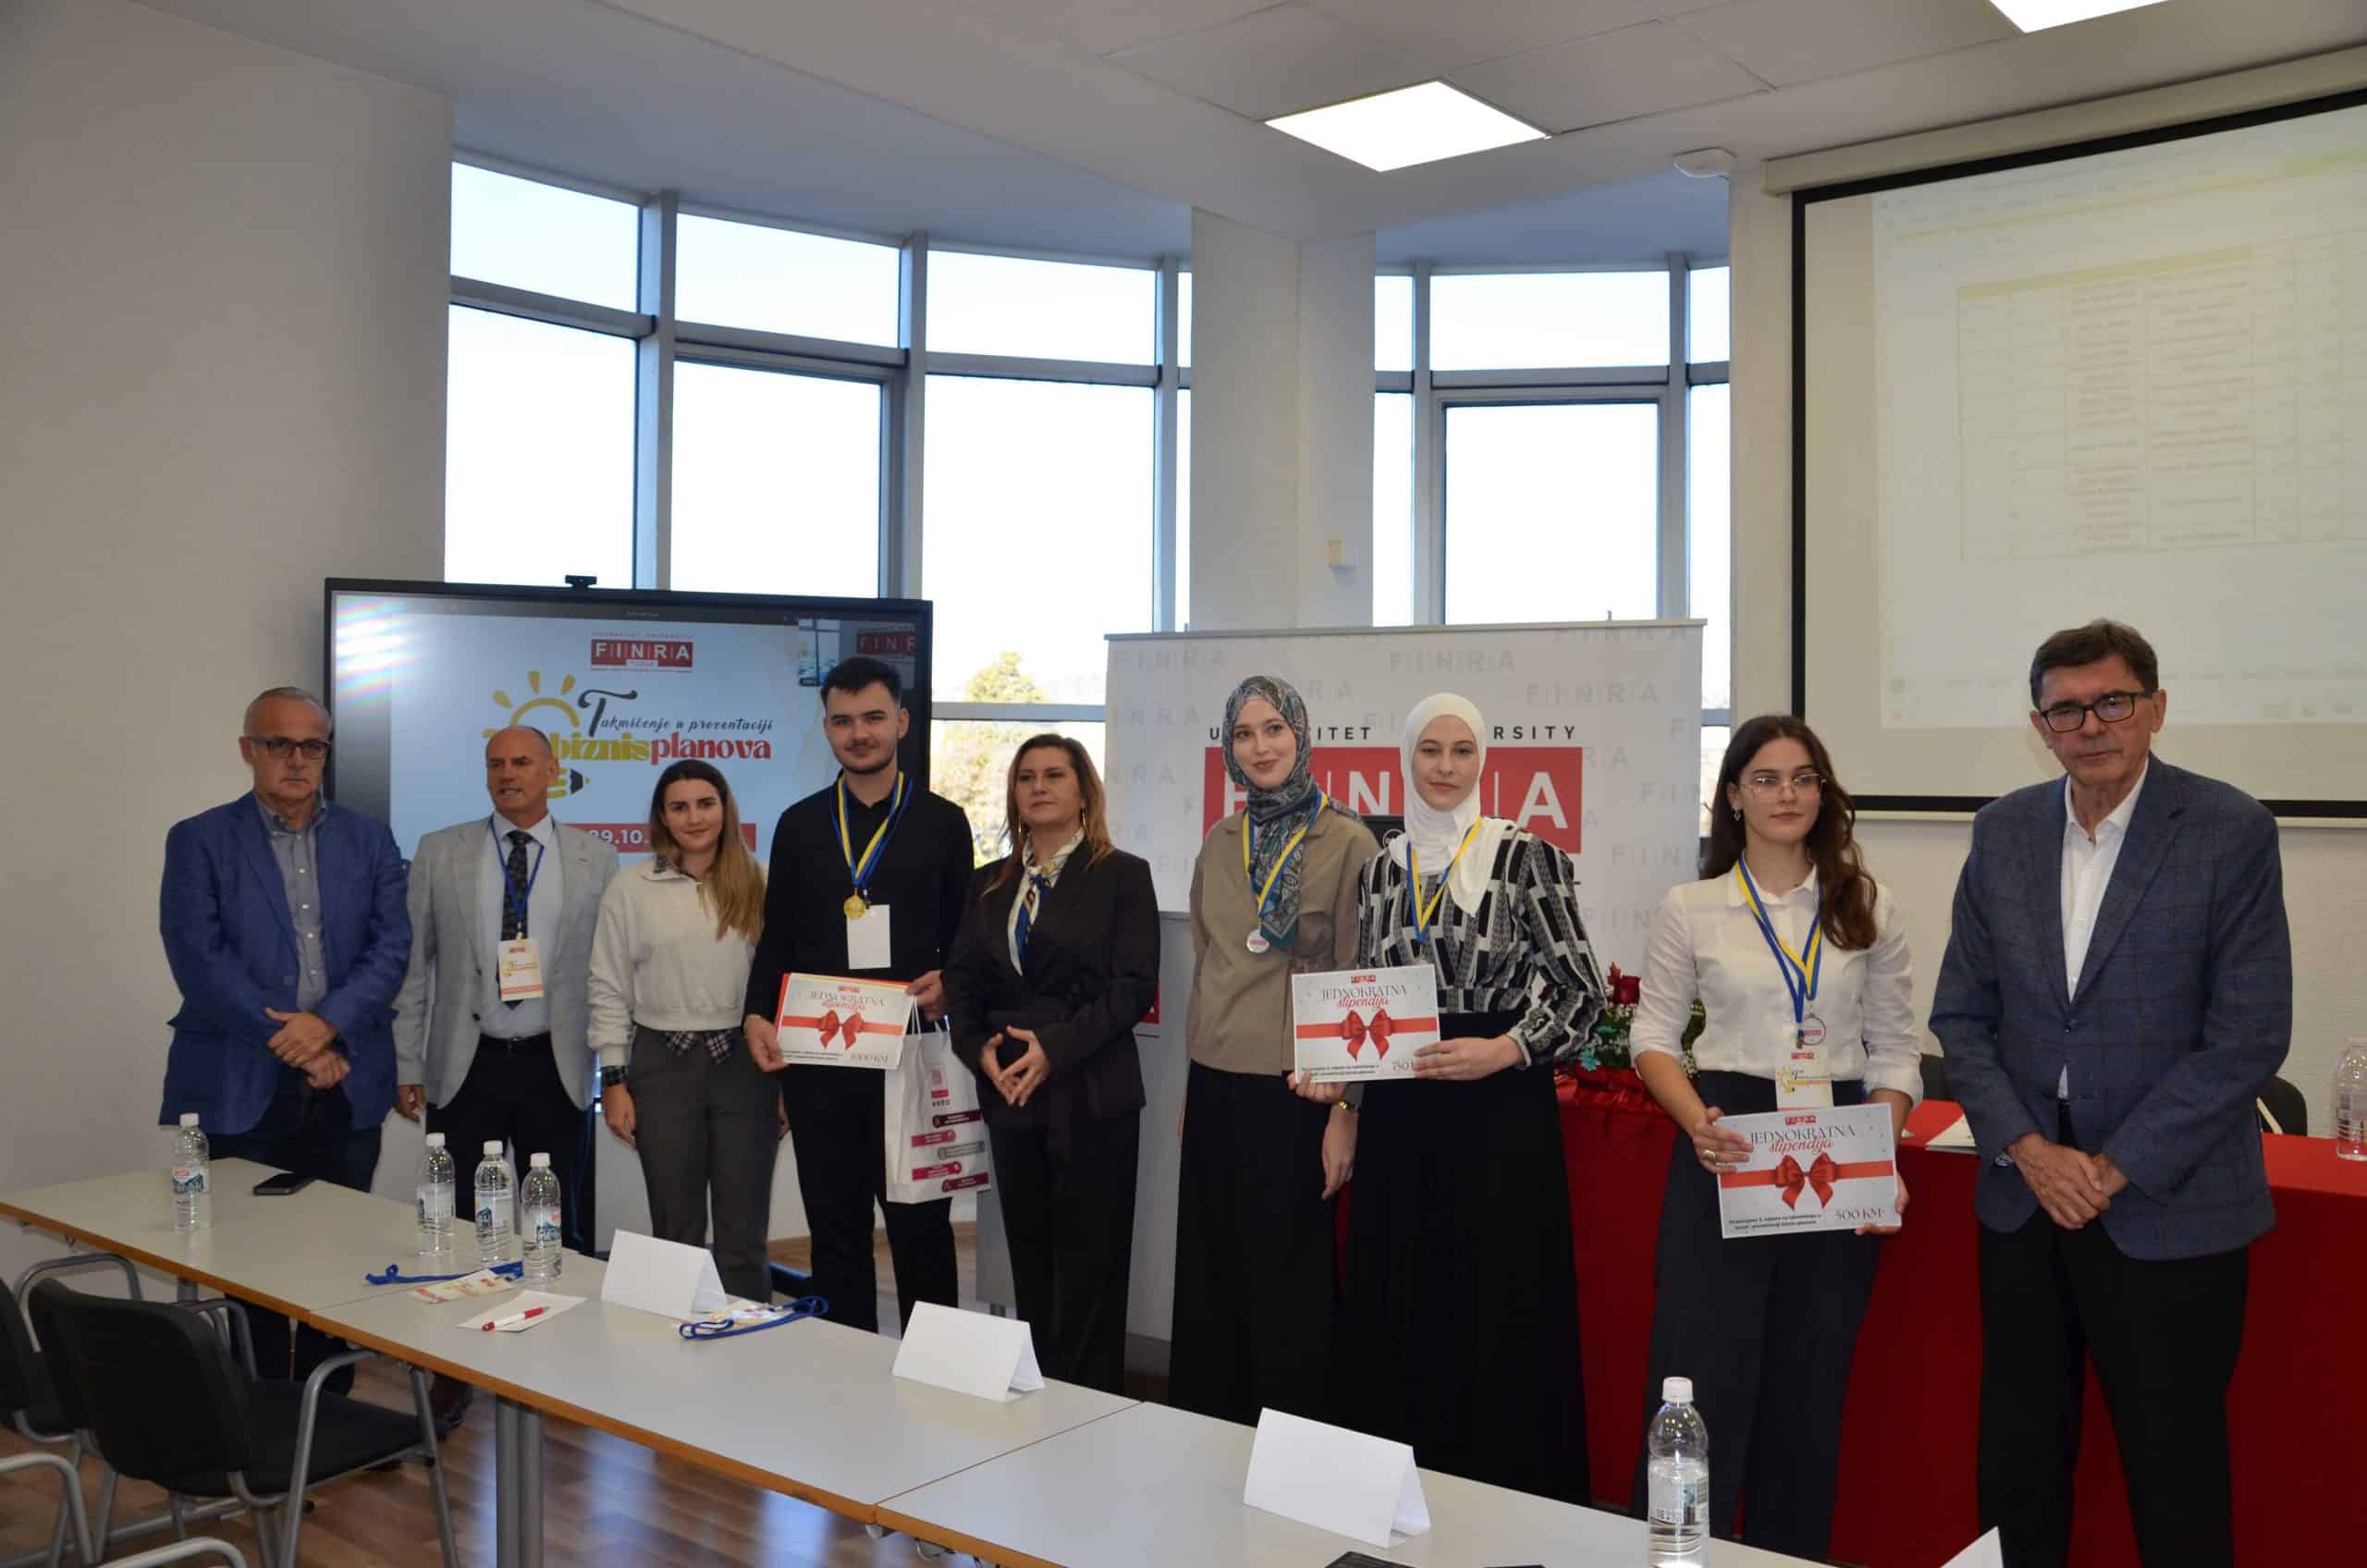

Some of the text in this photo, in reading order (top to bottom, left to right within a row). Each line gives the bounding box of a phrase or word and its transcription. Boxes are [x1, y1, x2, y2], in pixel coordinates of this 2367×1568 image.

[595, 643, 690, 659] FINRA
[1389, 651, 1516, 674] FINRA
[1527, 683, 1658, 704] FINRA
[688, 717, 774, 734] prezentaciji
[1493, 725, 1576, 741] RSITY
[1750, 1123, 1858, 1145] JEDNOKRATNA
